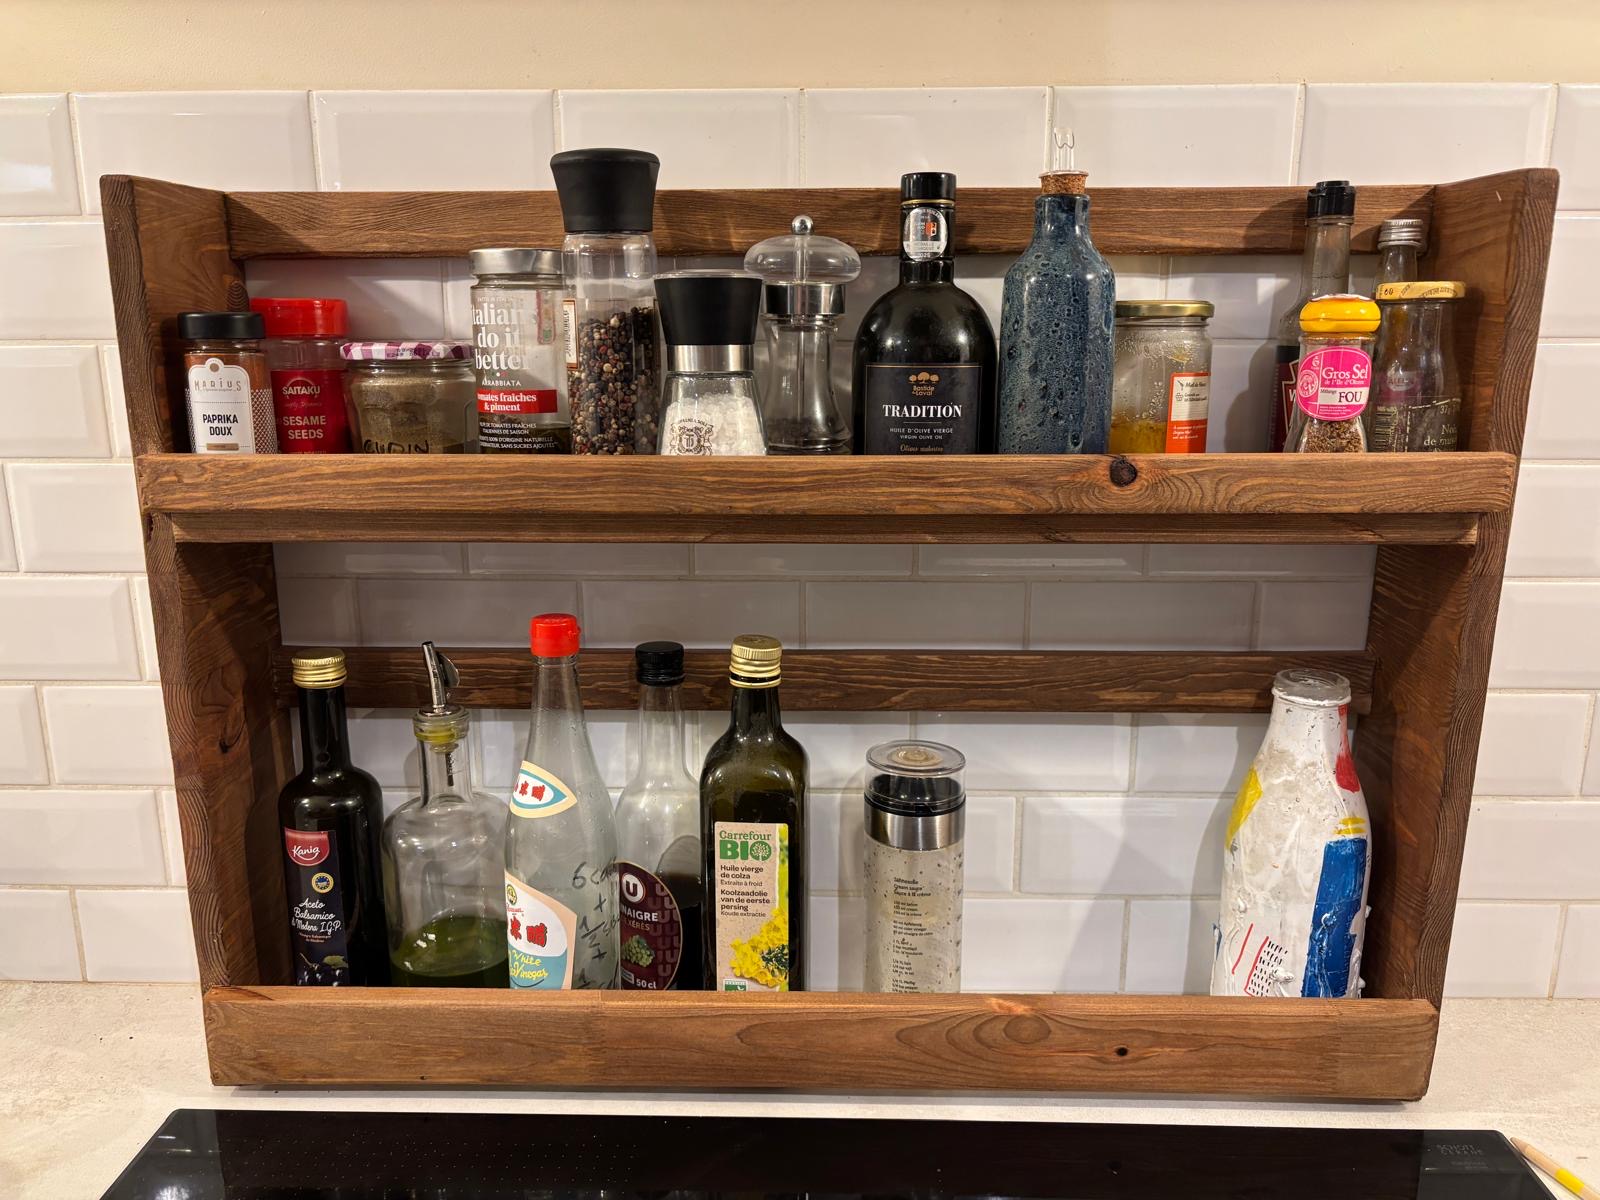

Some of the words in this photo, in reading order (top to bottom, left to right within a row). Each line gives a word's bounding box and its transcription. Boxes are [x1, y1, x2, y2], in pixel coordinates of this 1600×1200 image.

[477, 327, 499, 348] do
[475, 348, 530, 370] better
[1322, 367, 1350, 379] Gros
[1352, 363, 1369, 379] Sel
[282, 385, 321, 395] SAITAKU
[1338, 391, 1362, 403] FOU
[882, 404, 963, 418] TRADITION
[202, 413, 239, 424] PAPRIKA
[282, 415, 327, 426] SESAME
[209, 426, 233, 436] DOUX
[288, 429, 324, 440] SEEDS
[719, 830, 772, 841] Carrefour
[292, 845, 321, 860] Kania
[719, 839, 772, 861] BIO
[741, 866, 764, 874] vierge
[720, 889, 769, 897] Koolzaadolie
[299, 897, 326, 909] Aceto
[720, 903, 749, 911] persing
[293, 906, 336, 920] Balsamico
[621, 904, 659, 922] NAIGRE
[296, 918, 319, 931] Modena
[319, 919, 342, 936] I.G.P.
[512, 949, 542, 967] White
[513, 961, 549, 980] Vinegar
[636, 978, 647, 988] 50
[648, 981, 657, 989] cl
